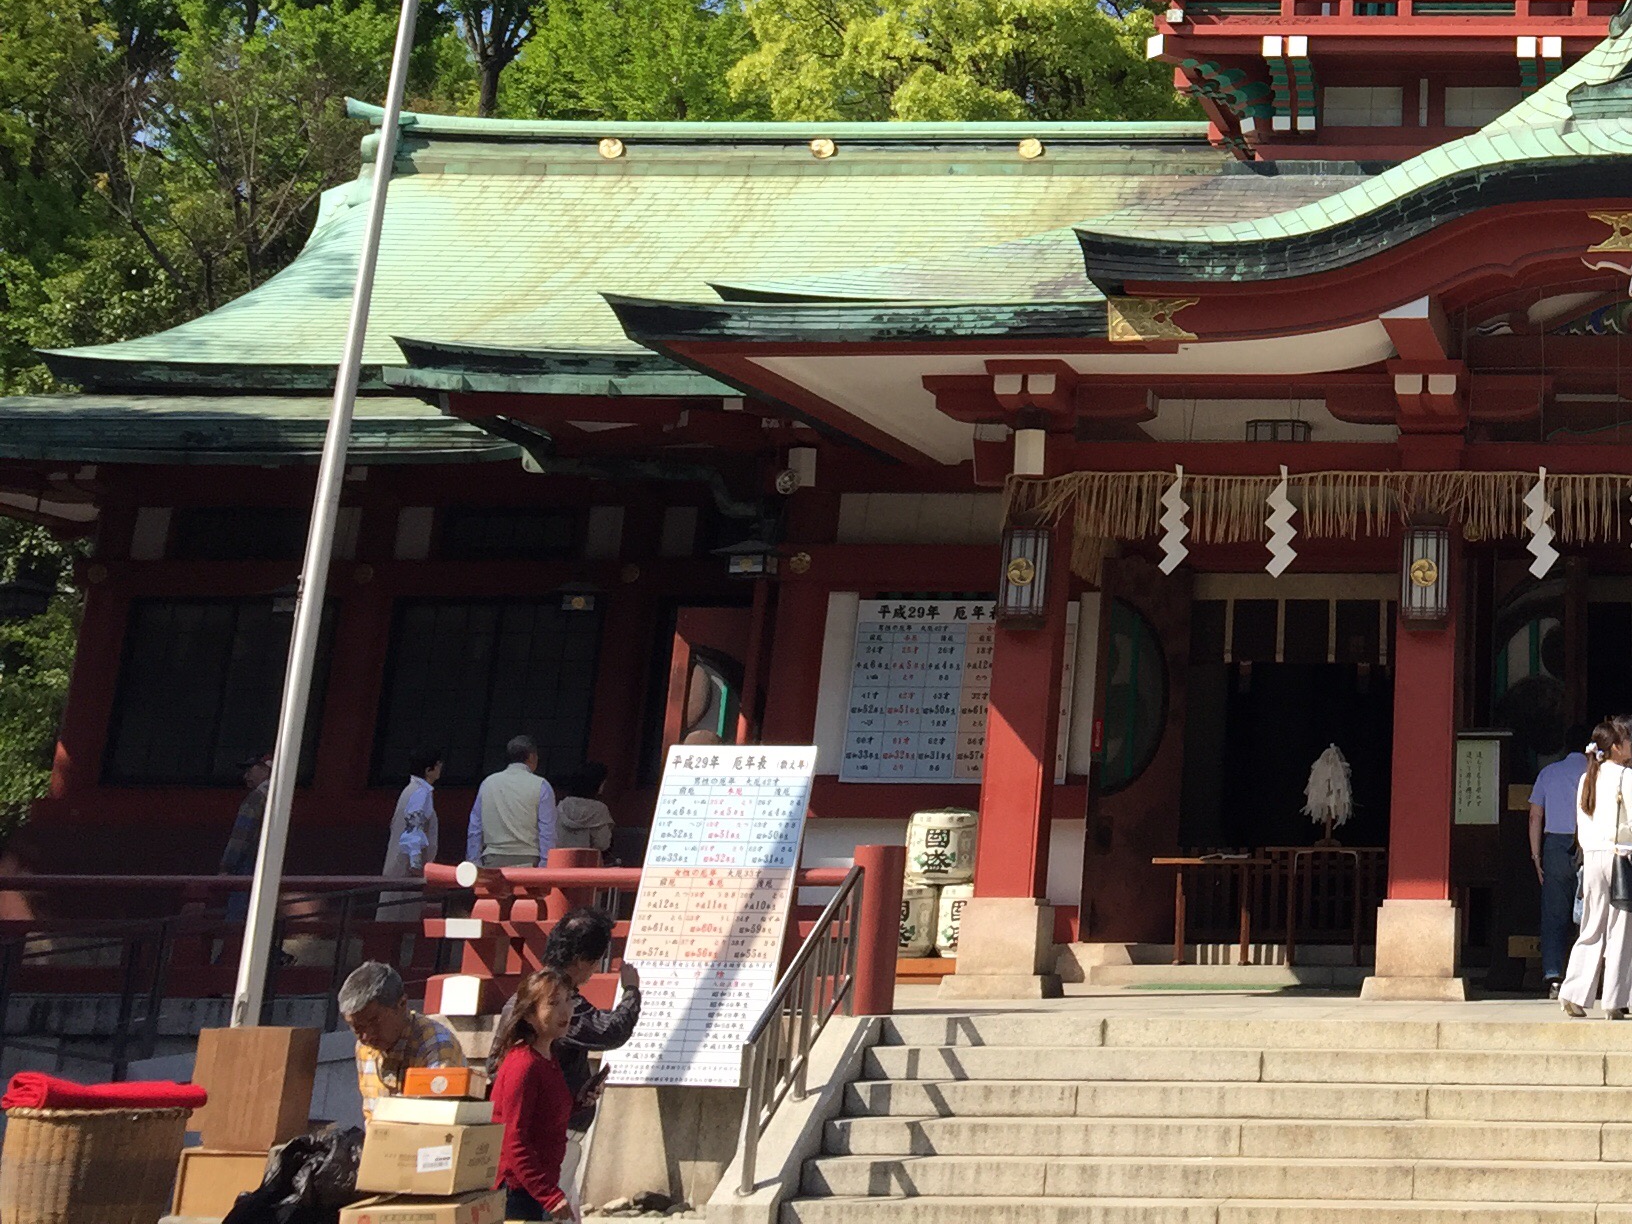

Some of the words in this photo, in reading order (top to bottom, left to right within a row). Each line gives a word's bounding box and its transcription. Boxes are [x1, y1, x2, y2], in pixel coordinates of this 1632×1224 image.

[878, 604, 940, 620] 平成29年
[671, 754, 720, 771] 平成29年
[732, 755, 767, 770] 厄年表
[922, 828, 952, 874] 國盛
